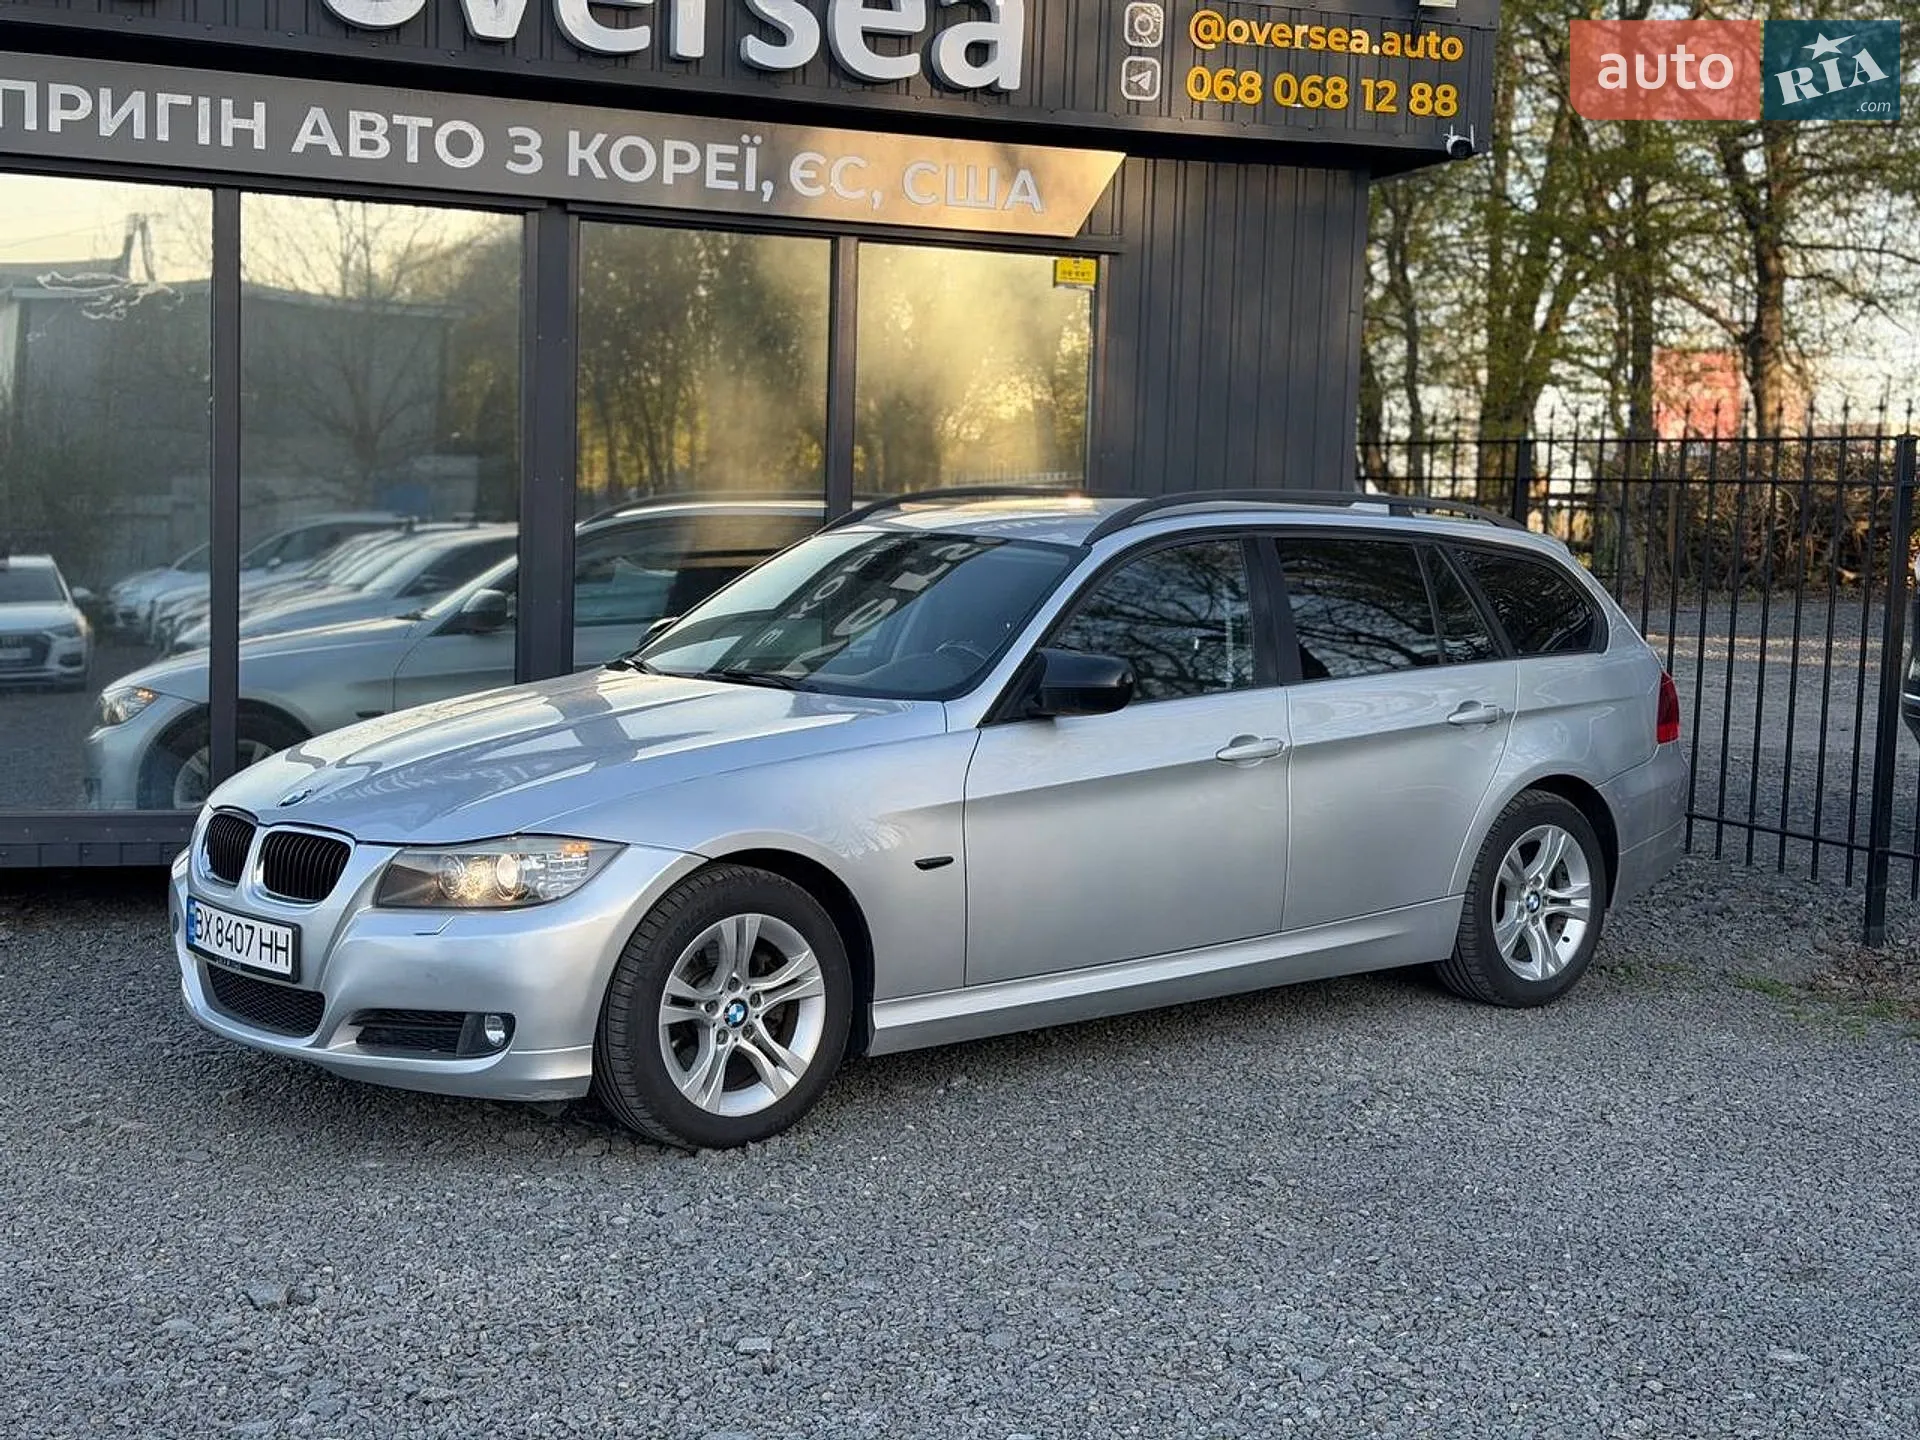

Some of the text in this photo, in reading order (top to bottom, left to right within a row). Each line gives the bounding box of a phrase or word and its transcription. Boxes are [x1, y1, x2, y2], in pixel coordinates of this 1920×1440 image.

[322, 0, 1025, 90] esea
[1189, 9, 1464, 61] @oversea.auto
[1187, 66, 1458, 116] 068 068 12 88
[0, 79, 267, 150] ПРИГІН
[291, 106, 485, 168] АВТО
[567, 130, 774, 202] КОРЕЇ,
[789, 151, 881, 210] ЄС,
[902, 161, 1043, 213] США
[216, 916, 255, 957] 8407
[259, 927, 289, 967] HH
